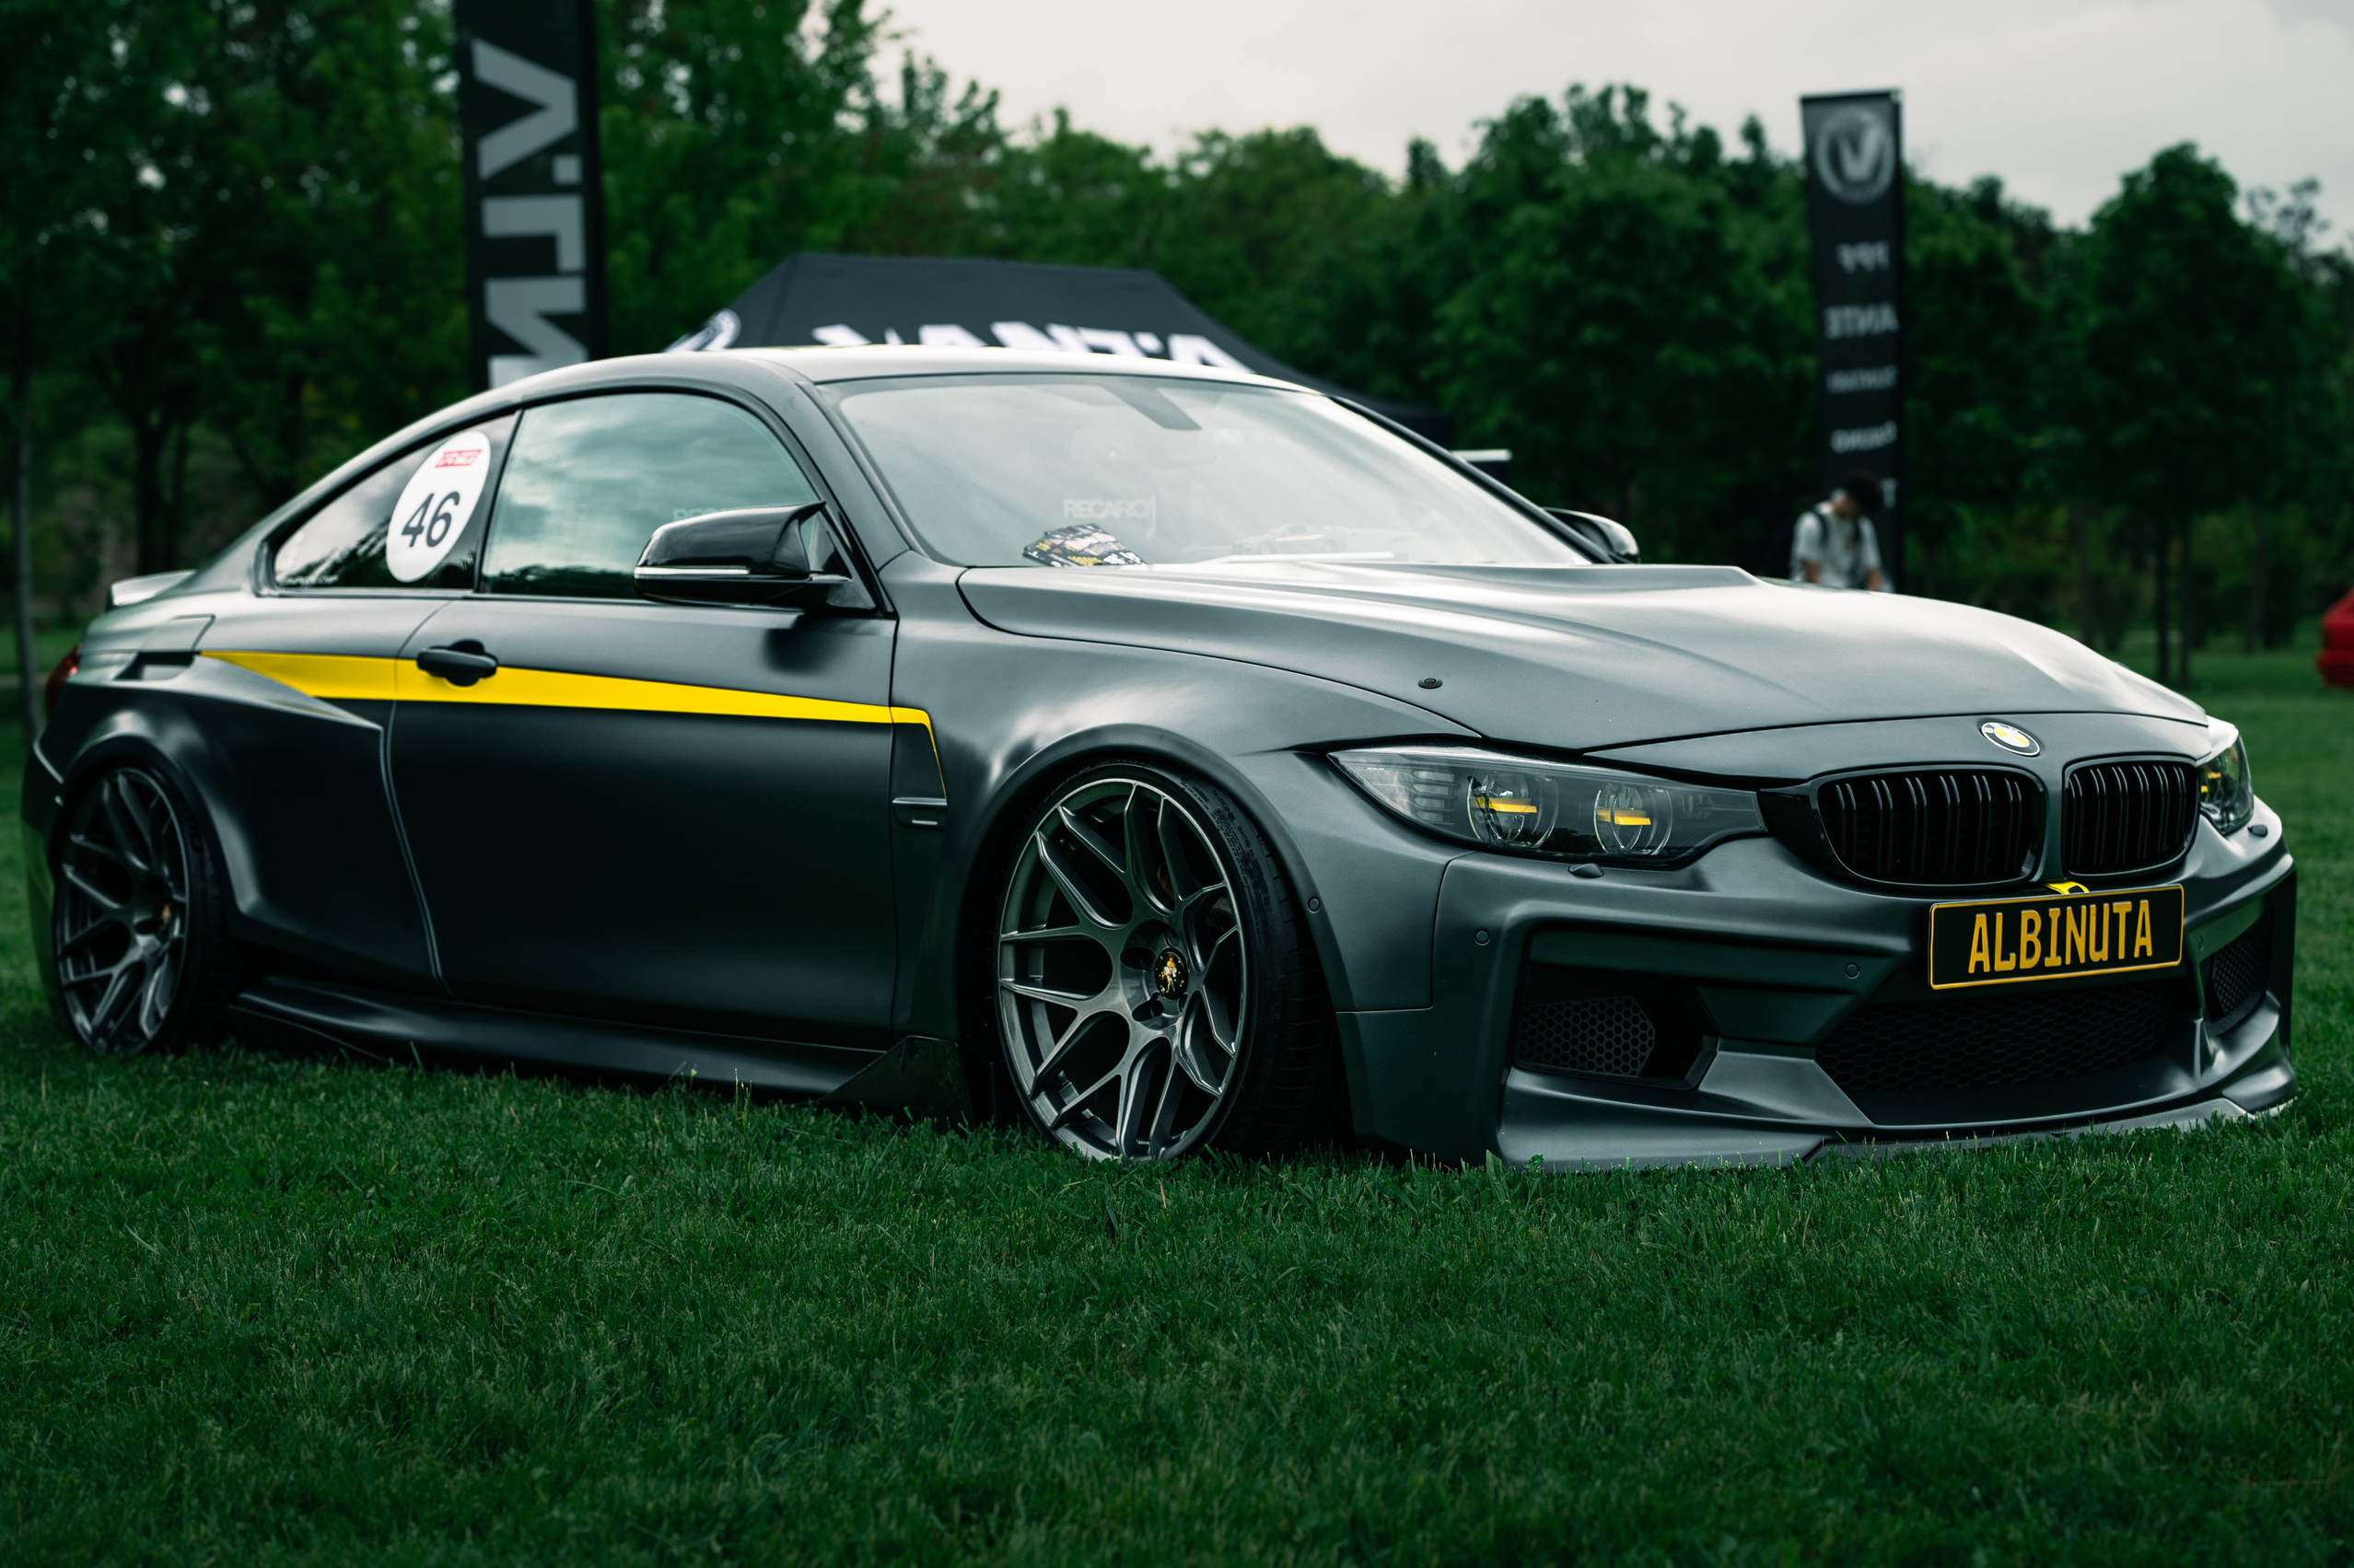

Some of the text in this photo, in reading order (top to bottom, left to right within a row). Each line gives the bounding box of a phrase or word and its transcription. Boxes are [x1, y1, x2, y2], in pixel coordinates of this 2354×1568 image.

[401, 491, 460, 548] 46
[1063, 498, 1149, 519] RECARO
[1968, 900, 2153, 974] ALBINUTA
